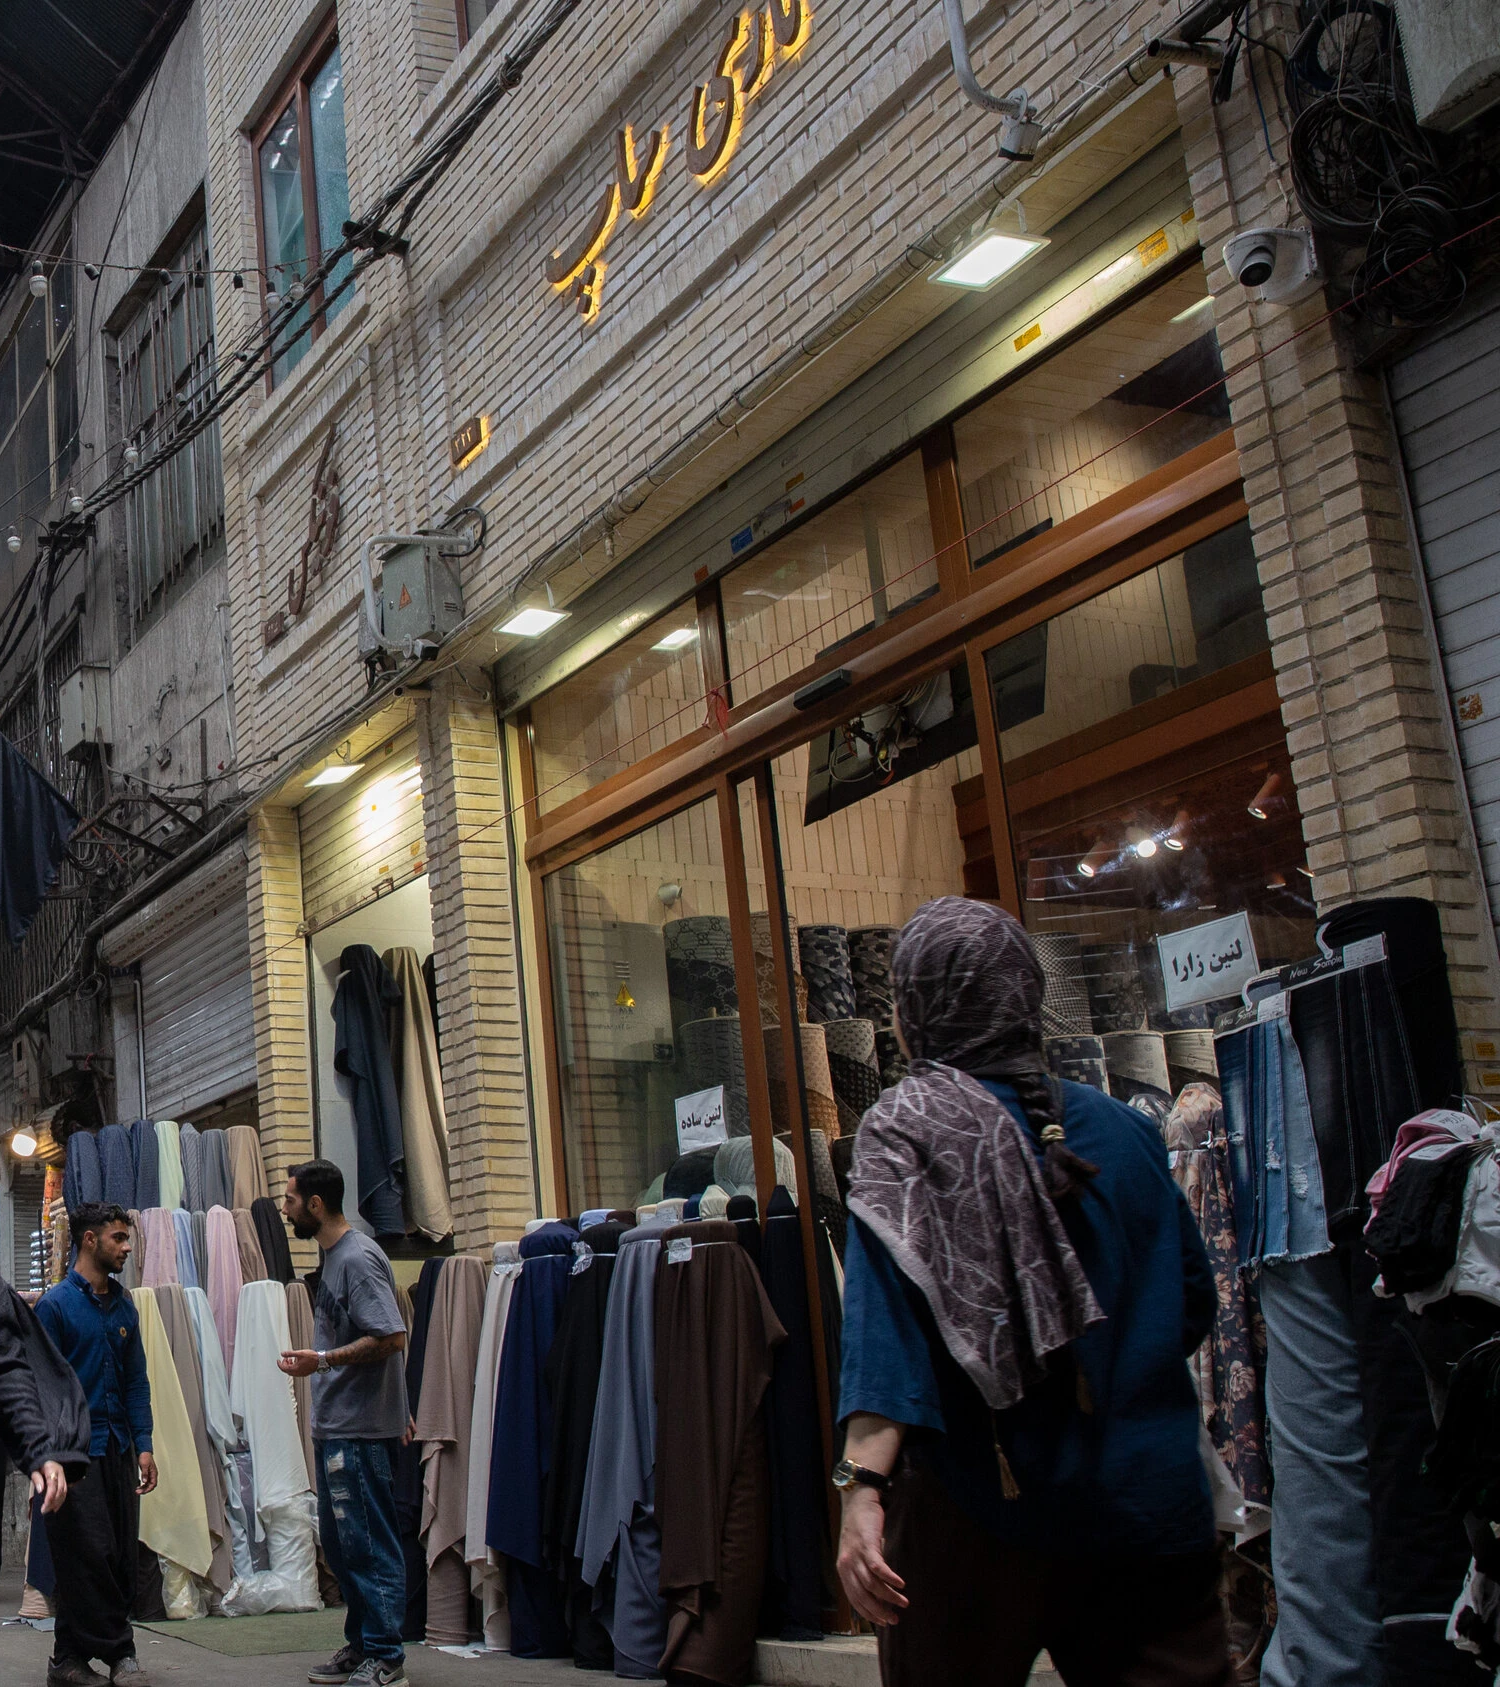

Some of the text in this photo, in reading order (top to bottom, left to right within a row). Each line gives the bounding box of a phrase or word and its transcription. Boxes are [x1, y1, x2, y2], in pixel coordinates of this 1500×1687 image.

[1172, 938, 1243, 982] لنین زارا
[681, 1104, 722, 1130] لنین ساده
